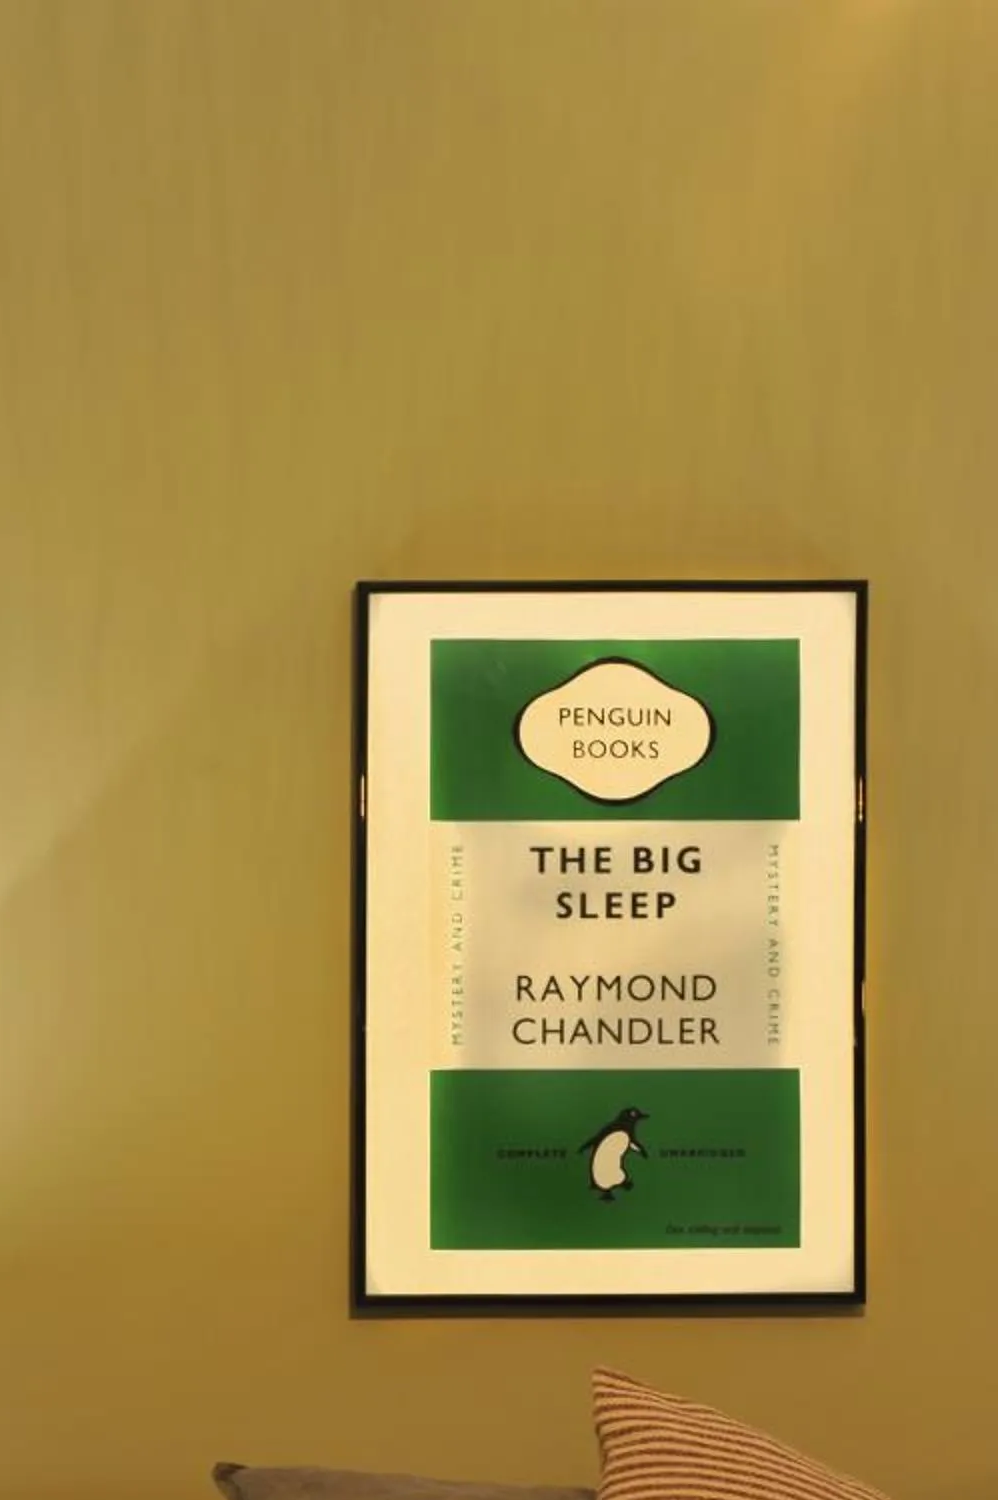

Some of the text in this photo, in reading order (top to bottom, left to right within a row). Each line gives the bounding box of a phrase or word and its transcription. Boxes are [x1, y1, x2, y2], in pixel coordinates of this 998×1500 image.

[558, 708, 672, 727] PENGUIN
[572, 740, 660, 759] BOOKS
[530, 847, 702, 874] THE BIG
[556, 892, 676, 920] SLEEP
[451, 845, 464, 1046] MYSTERY AND CRIME
[767, 844, 781, 1046] MYSTERY AND CRIME
[516, 975, 717, 1001] RAYMOND
[512, 1018, 720, 1045] CHANDLER
